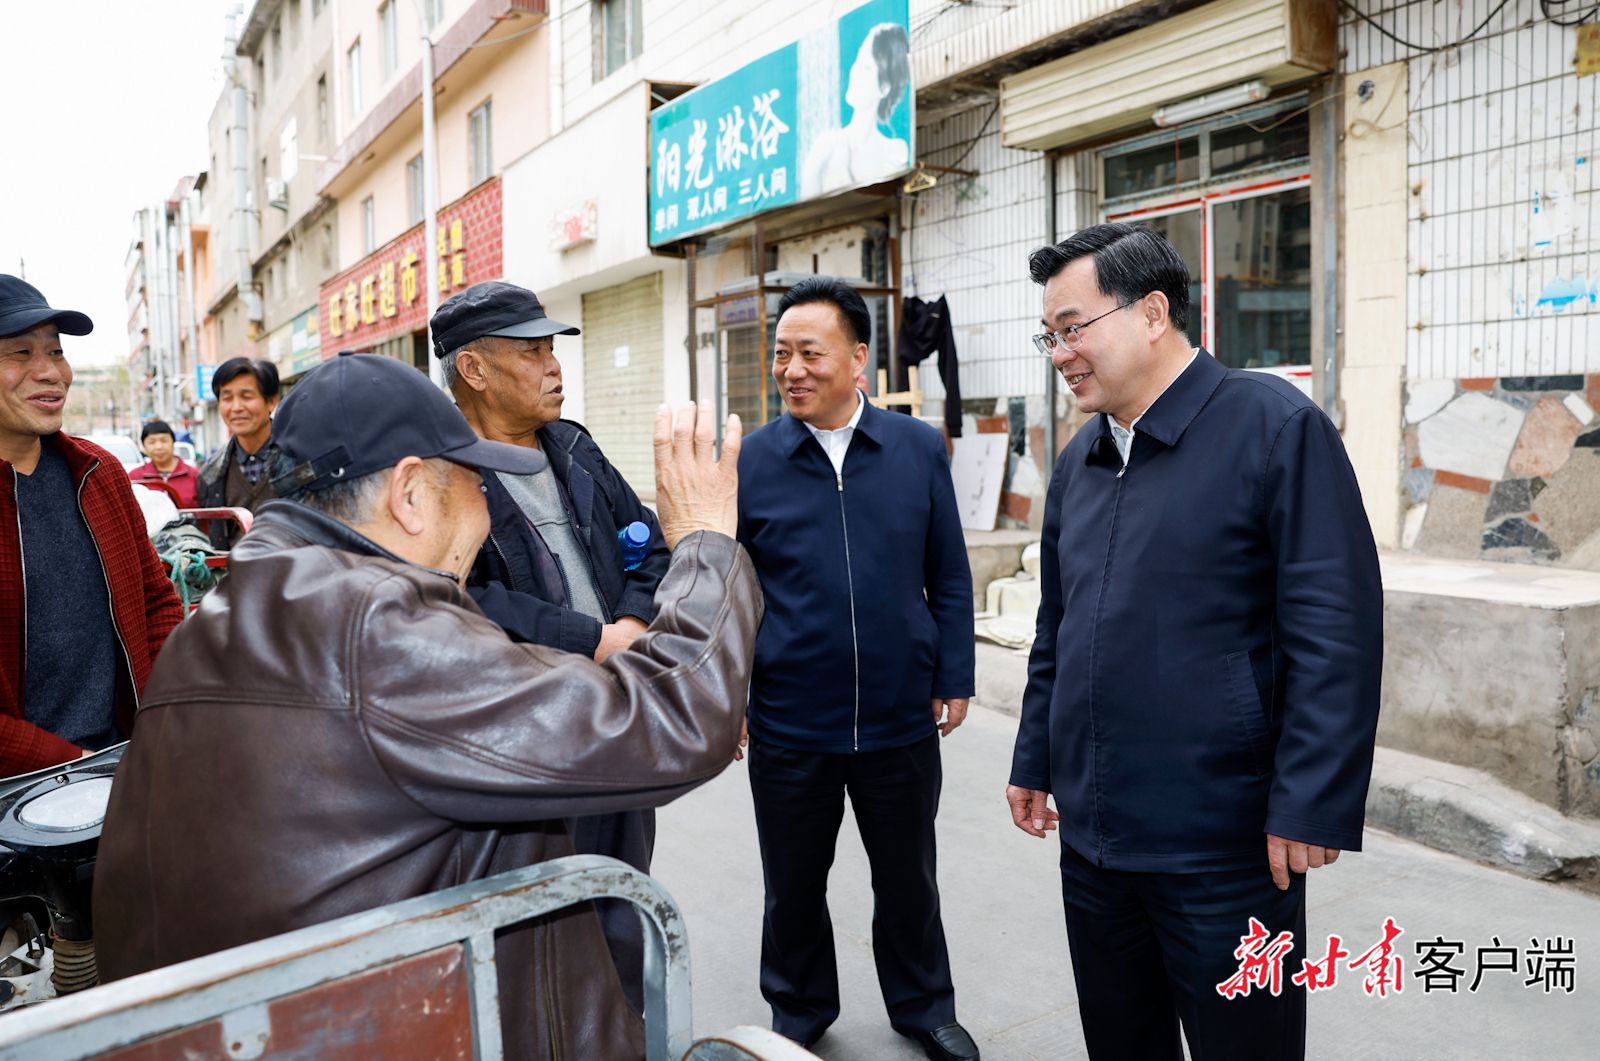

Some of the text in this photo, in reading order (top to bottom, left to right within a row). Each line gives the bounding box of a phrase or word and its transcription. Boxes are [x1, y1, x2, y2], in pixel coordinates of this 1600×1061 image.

[657, 88, 790, 198] 阳光淋浴
[686, 185, 728, 221] 双人间
[738, 166, 787, 205] 三人间
